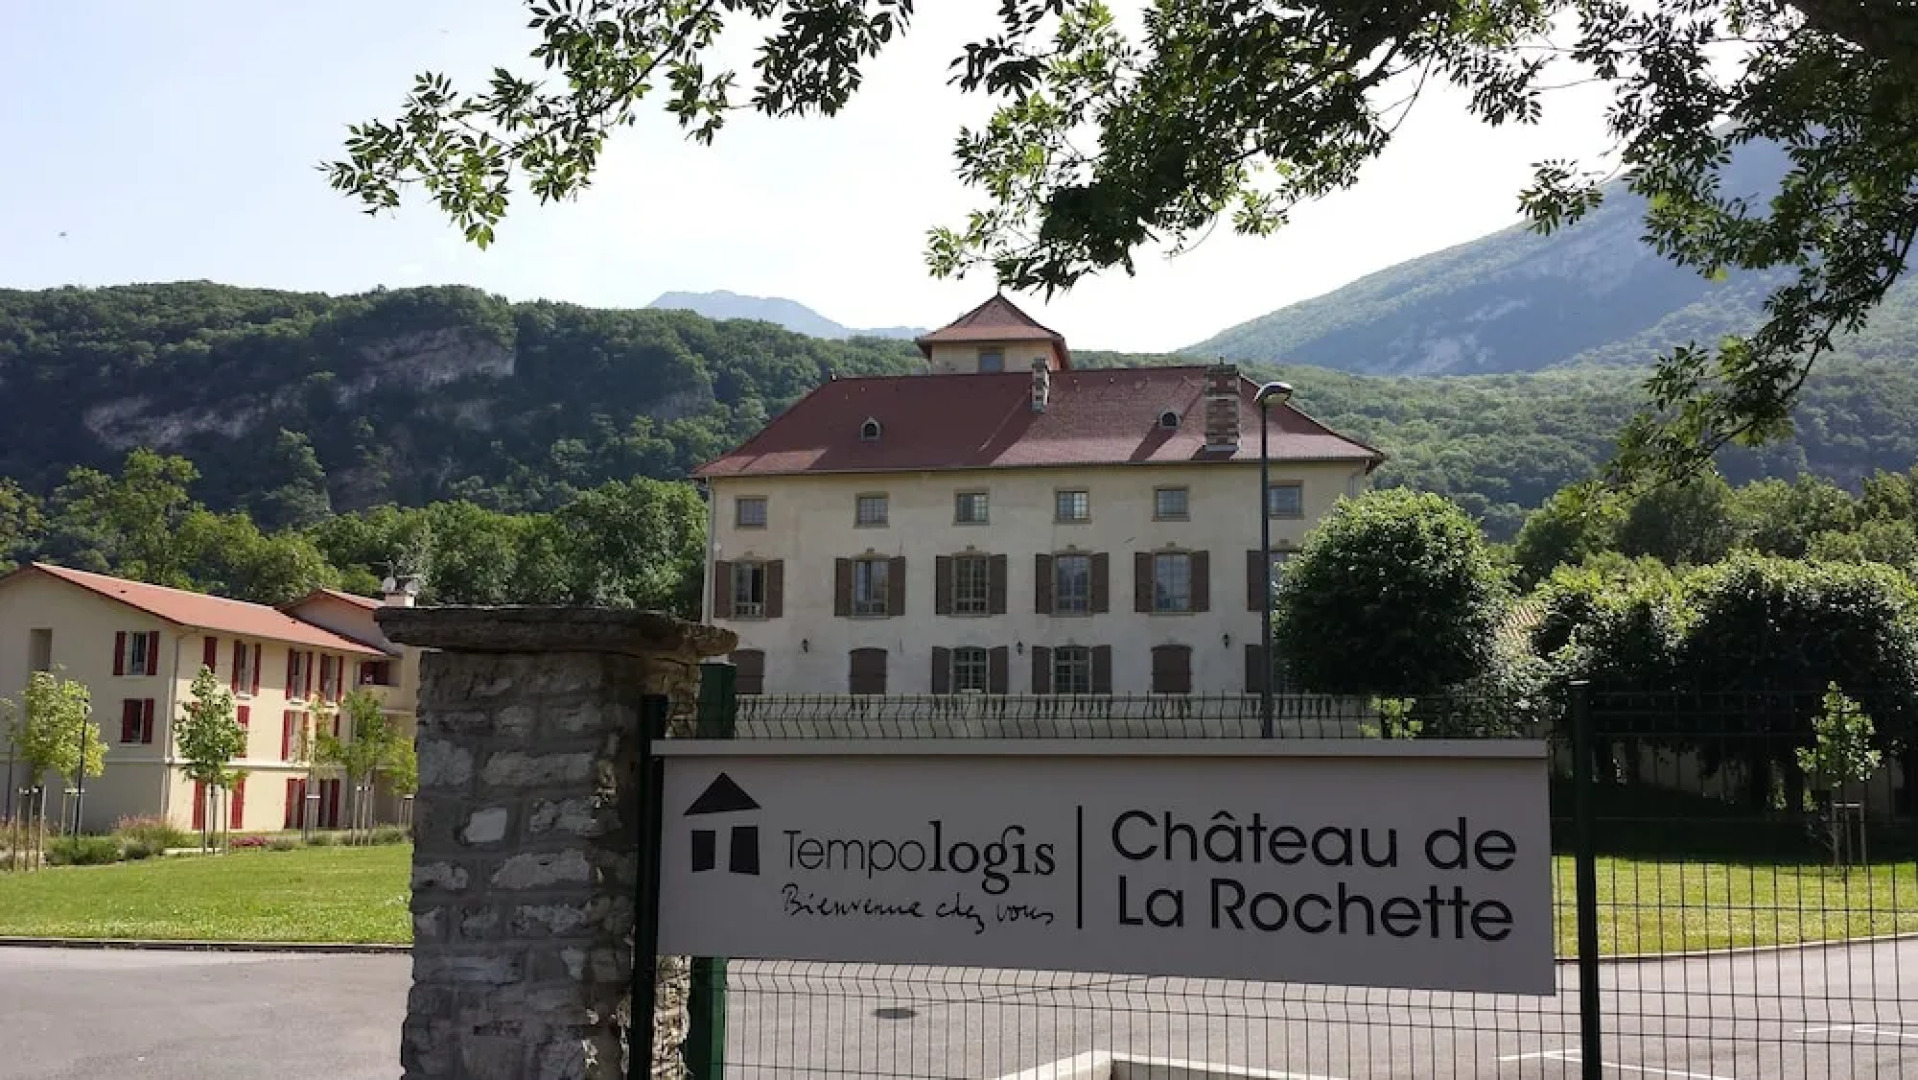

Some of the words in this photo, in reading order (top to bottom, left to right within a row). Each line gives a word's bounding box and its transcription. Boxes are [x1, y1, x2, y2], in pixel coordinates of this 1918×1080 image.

[783, 820, 1056, 896] Tempologis
[1112, 809, 1398, 869] Château
[1424, 816, 1518, 872] de
[781, 882, 924, 918] Bienvenue
[936, 891, 985, 935] chez
[997, 903, 1055, 927] vous
[1117, 874, 1185, 929] La
[1209, 877, 1515, 943] Rochette
